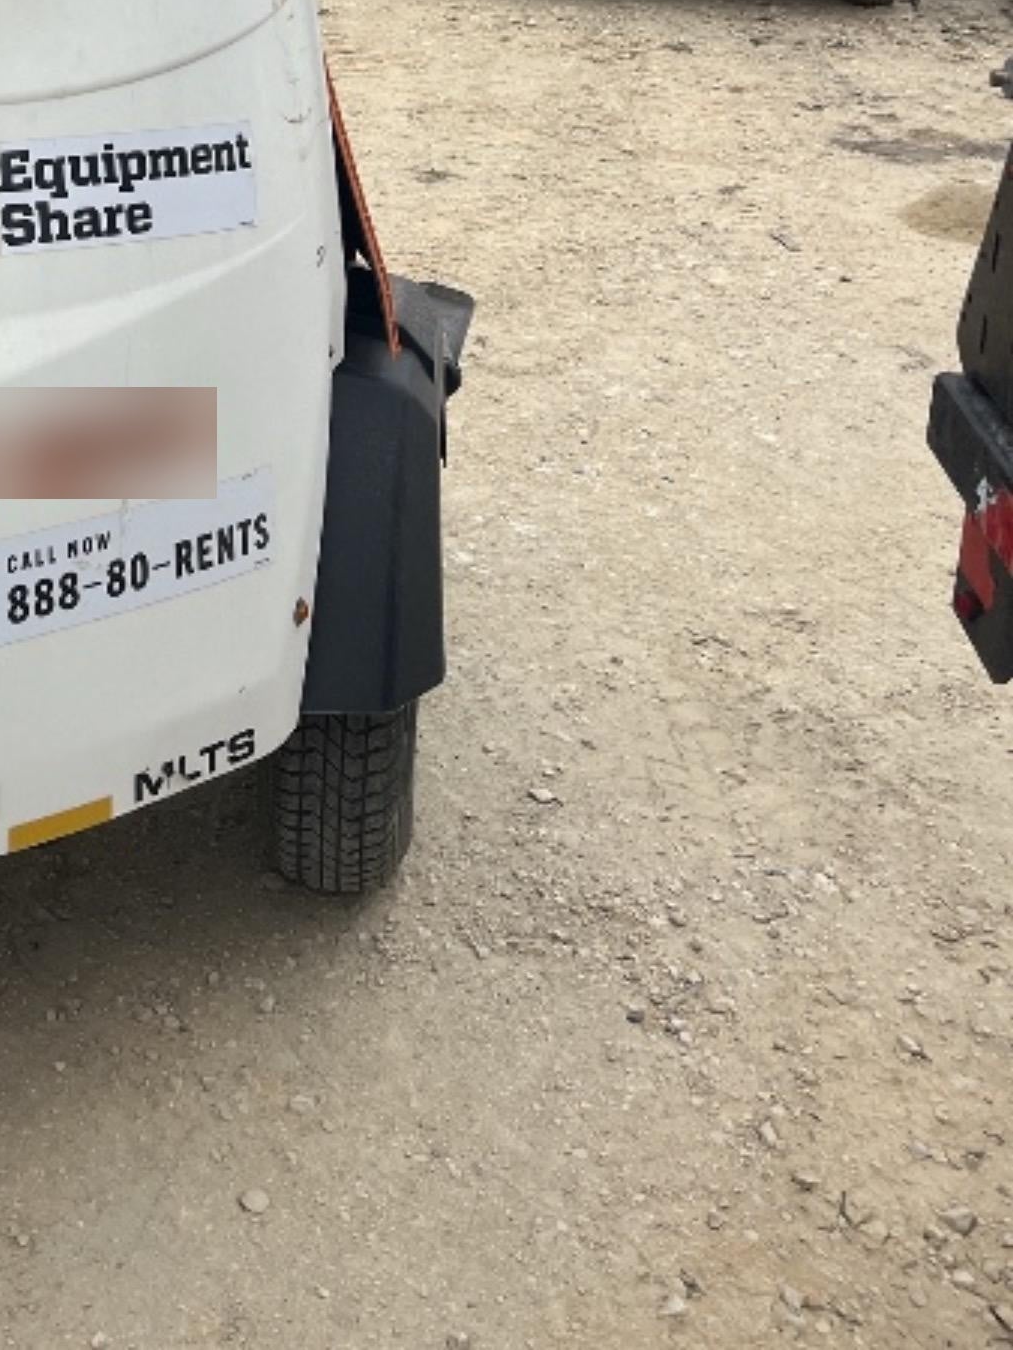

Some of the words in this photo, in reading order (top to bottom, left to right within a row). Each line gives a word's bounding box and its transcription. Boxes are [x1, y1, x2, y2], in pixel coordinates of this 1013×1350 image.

[0, 200, 154, 247] Share
[6, 544, 57, 574] CALL
[67, 531, 113, 561] NOW
[7, 512, 271, 625] 888-80-RENTS
